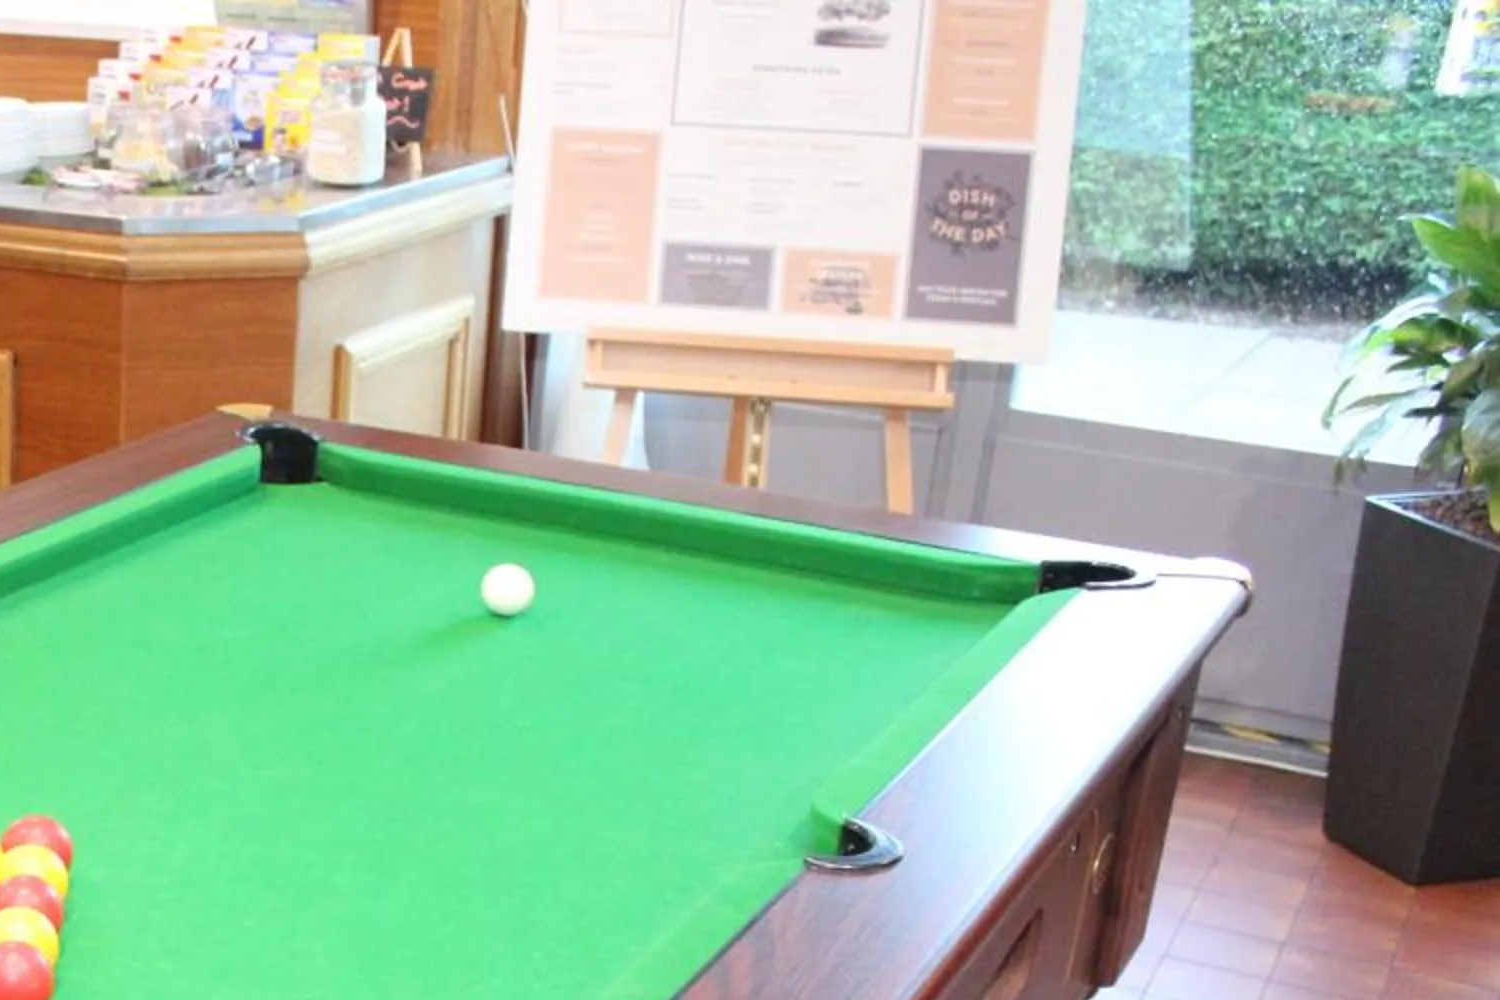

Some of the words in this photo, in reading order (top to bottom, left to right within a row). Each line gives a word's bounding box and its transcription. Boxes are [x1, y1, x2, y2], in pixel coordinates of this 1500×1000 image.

[949, 189, 995, 207] DISH
[931, 217, 966, 242] THE
[972, 221, 1005, 243] DAY
